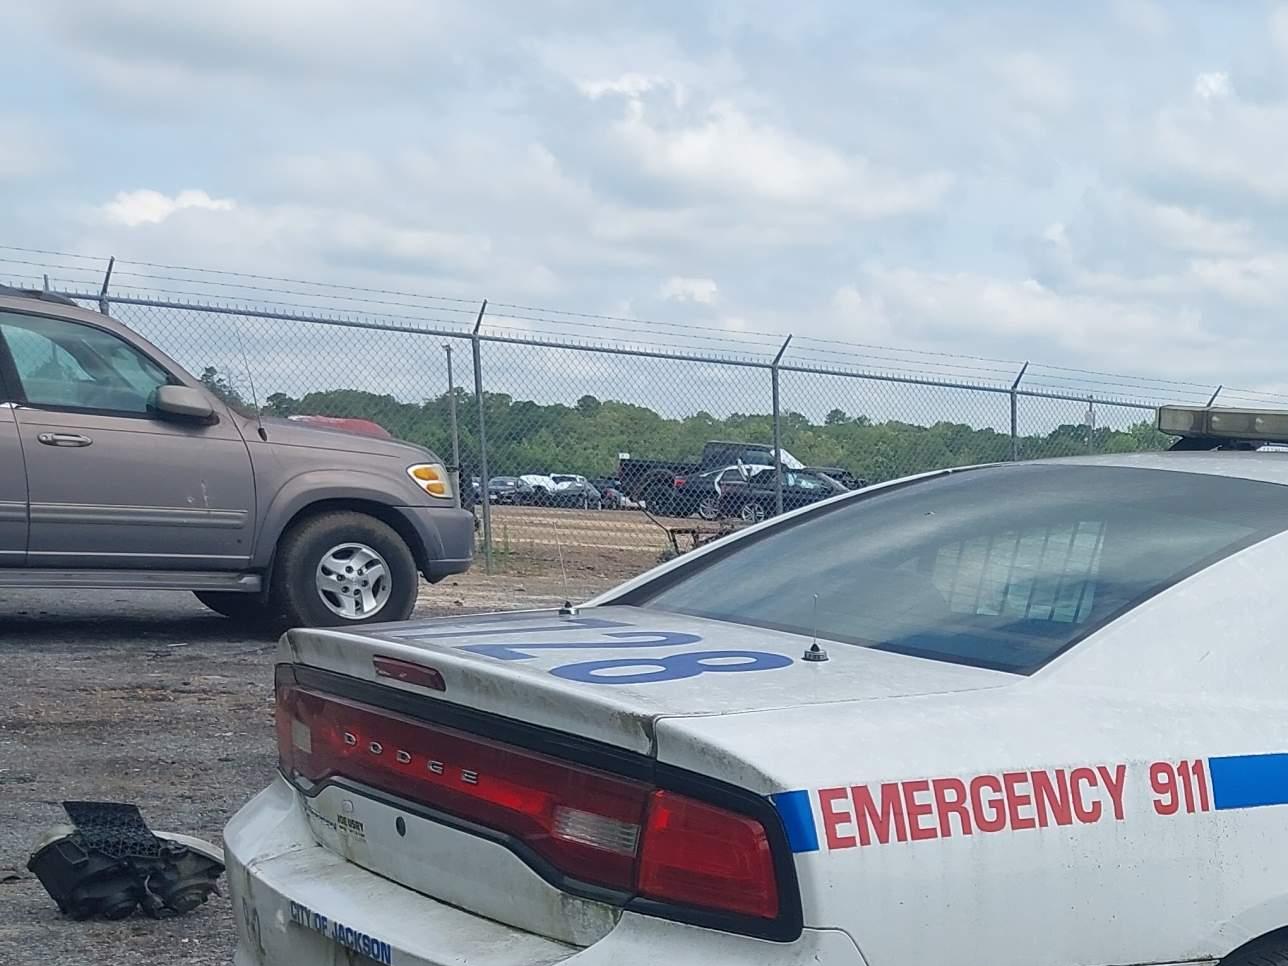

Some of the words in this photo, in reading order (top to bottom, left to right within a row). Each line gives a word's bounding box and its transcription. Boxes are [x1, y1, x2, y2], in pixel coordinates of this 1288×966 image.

[344, 732, 479, 785] DODGE
[818, 764, 1126, 850] EMERGENCY
[1150, 760, 1209, 815] 911
[290, 900, 311, 929] CITY
[314, 912, 328, 936] OF
[331, 921, 391, 963] JACKSON
